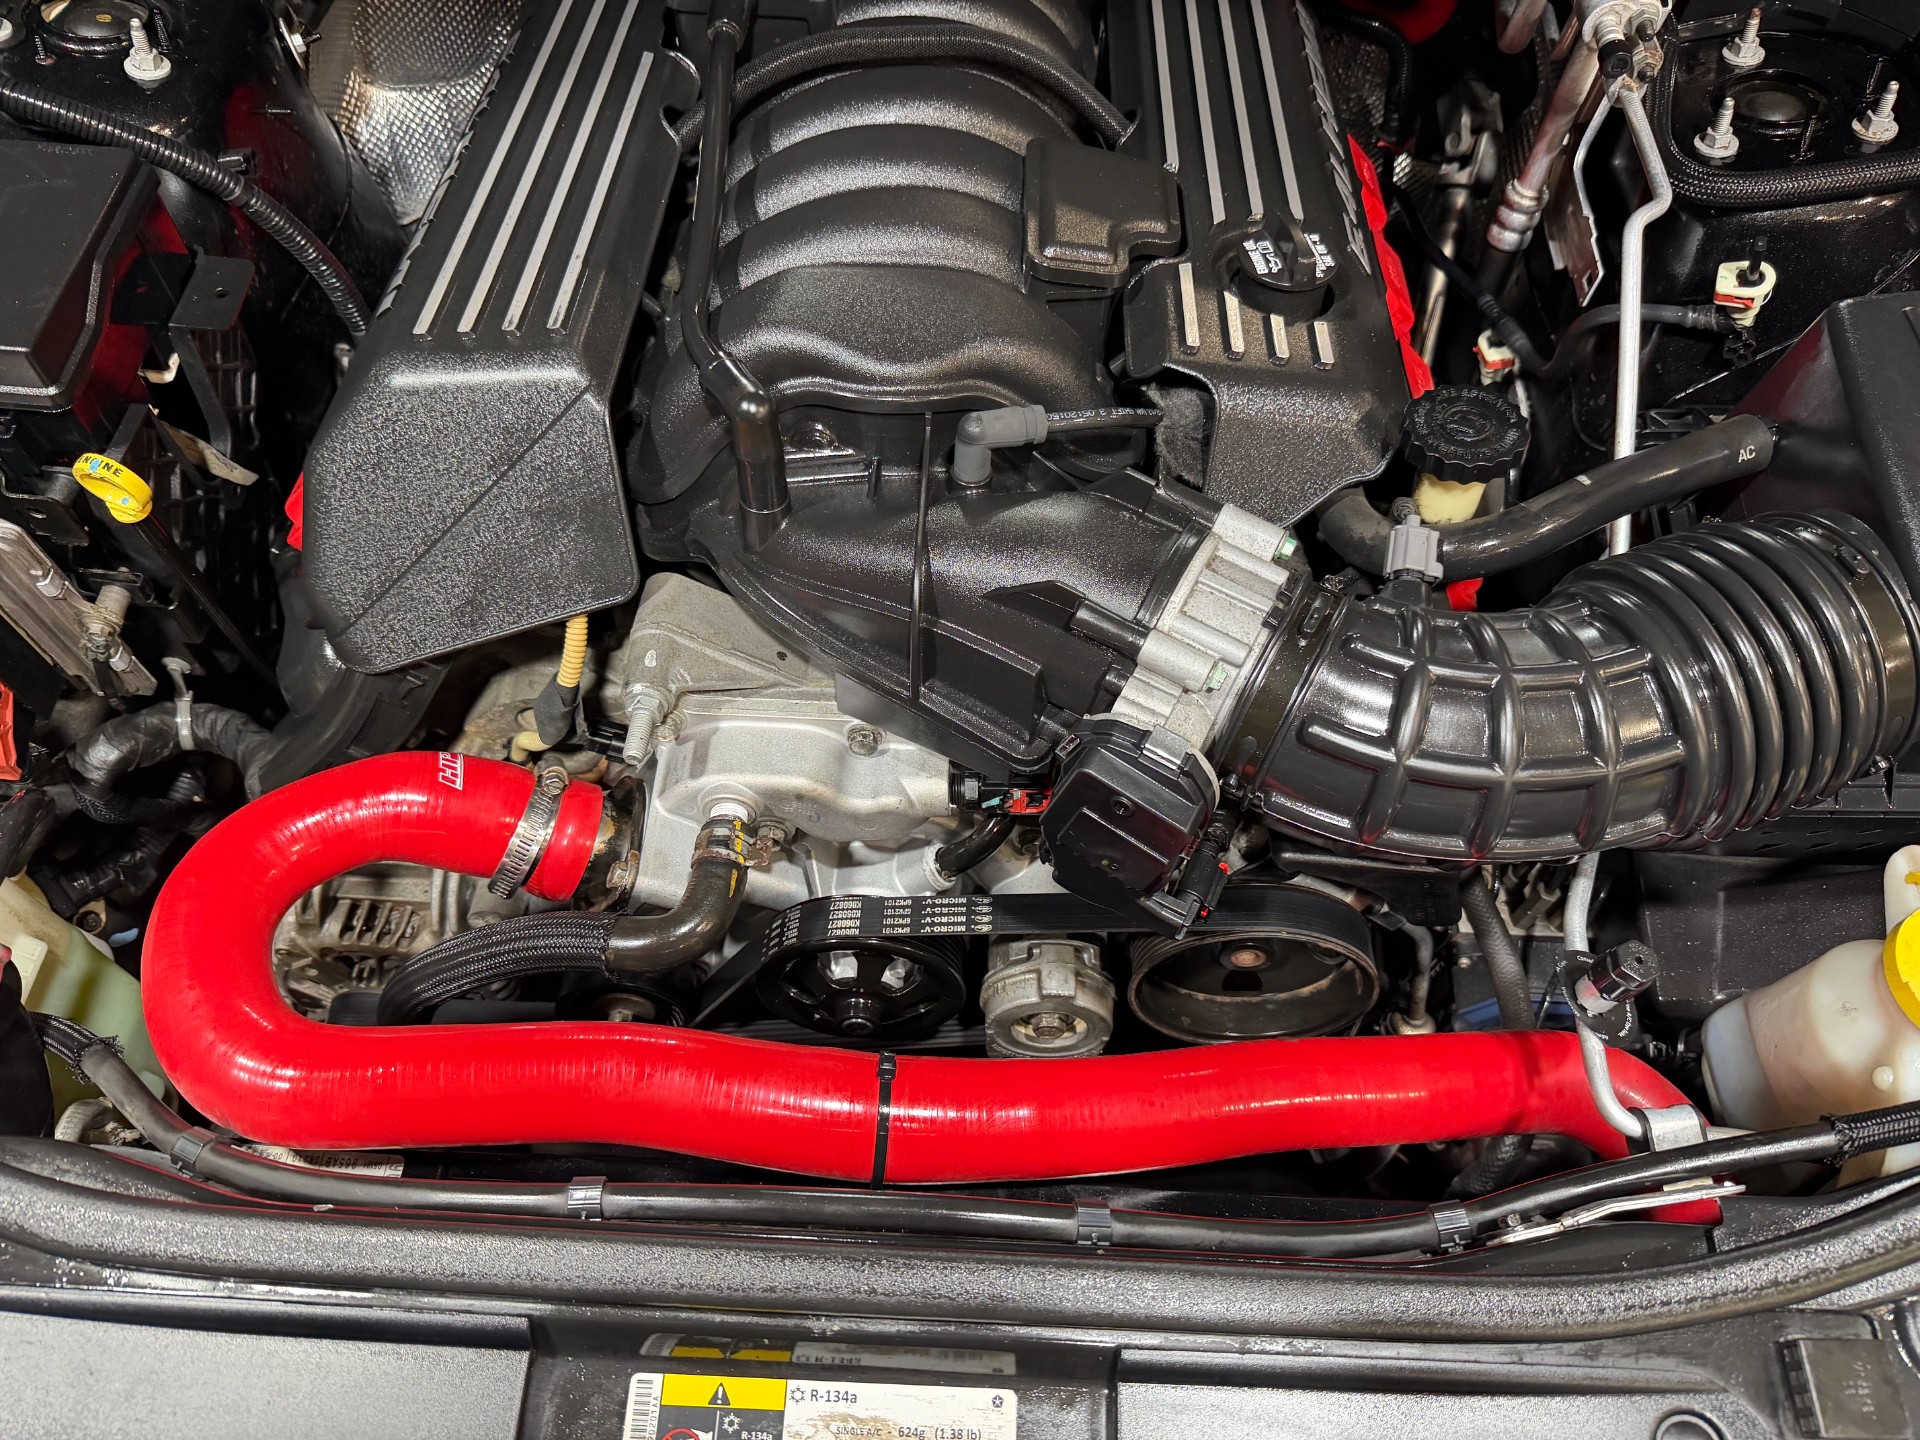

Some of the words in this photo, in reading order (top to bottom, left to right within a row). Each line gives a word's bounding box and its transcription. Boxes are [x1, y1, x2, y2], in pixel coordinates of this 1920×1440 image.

[1248, 250, 1269, 275] ENGINE
[1738, 445, 1756, 463] AC
[77, 455, 124, 478] ENINE
[828, 919, 860, 929] K060827
[811, 1389, 858, 1404] R-134a
[741, 1431, 773, 1440] R-134a
[836, 1426, 865, 1436] SINGLE
[866, 1428, 882, 1437] A/C
[898, 1426, 926, 1440] 624g
[935, 1427, 964, 1440] (1.38
[966, 1428, 982, 1440] lb)
